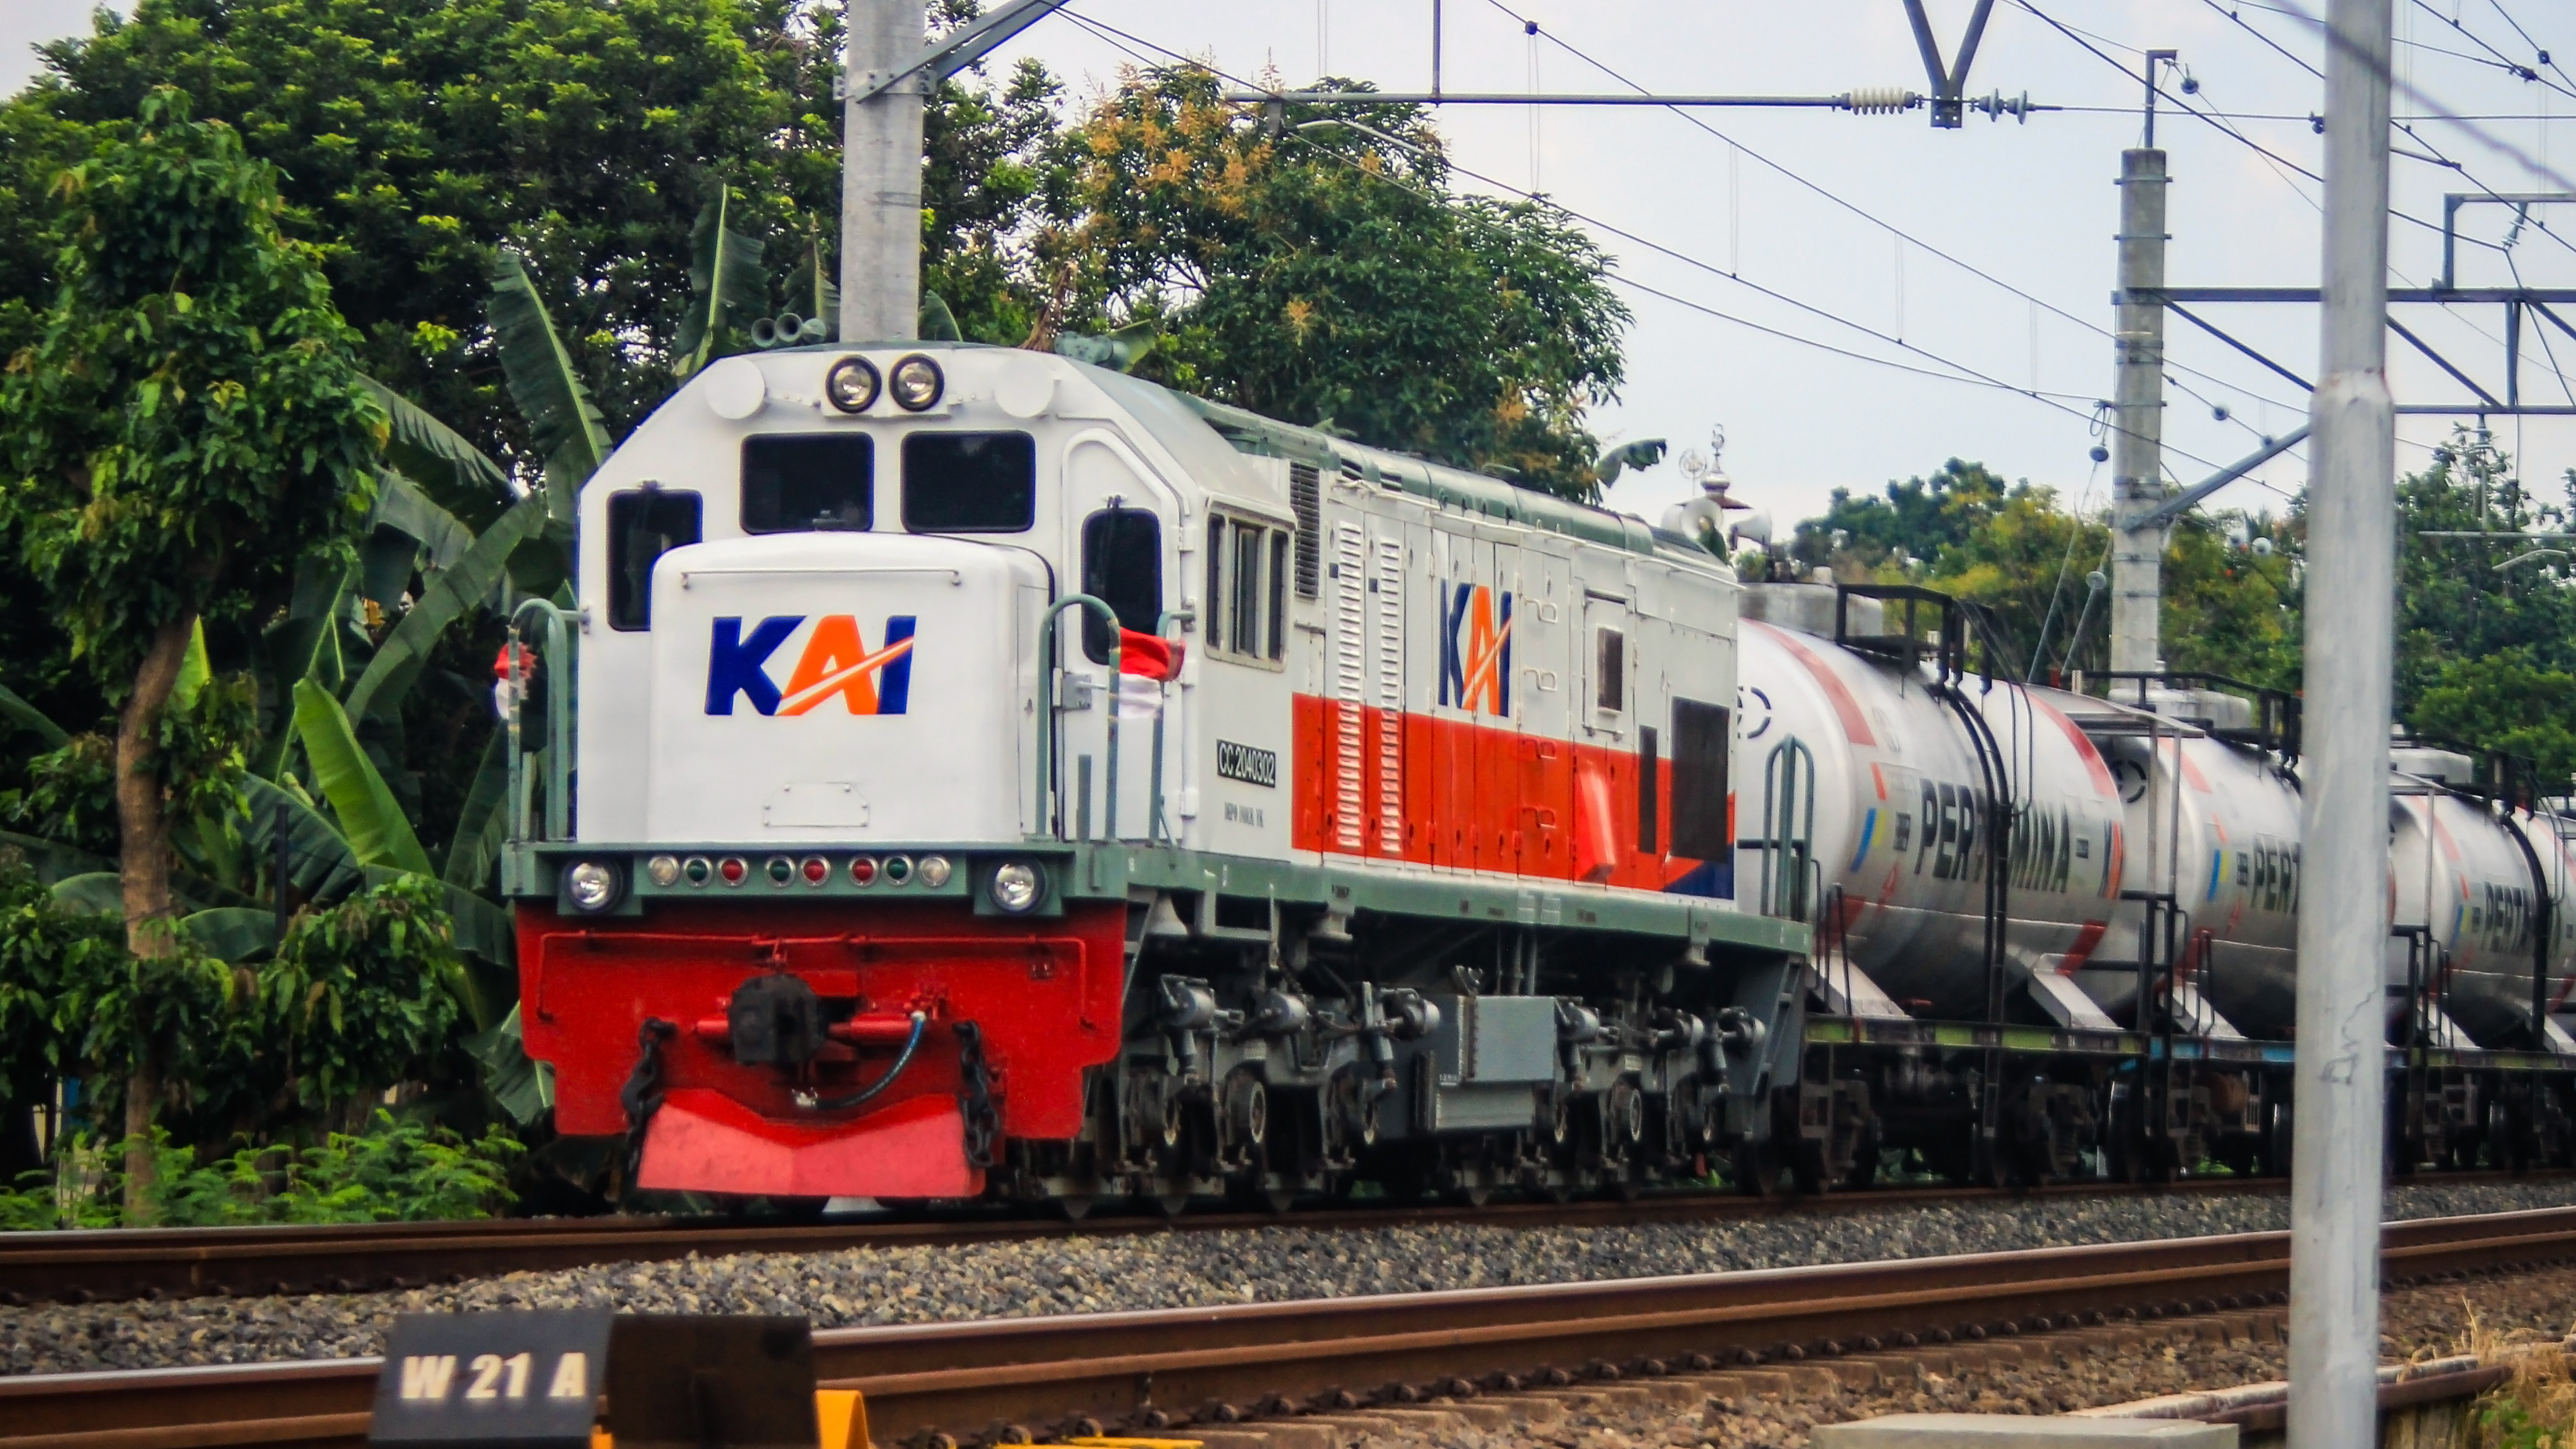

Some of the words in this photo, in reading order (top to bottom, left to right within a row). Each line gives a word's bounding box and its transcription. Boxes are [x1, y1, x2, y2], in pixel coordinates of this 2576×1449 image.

[705, 615, 917, 715] KAI
[1438, 579, 1511, 717] KAI
[1219, 743, 1233, 775] CC
[1235, 746, 1275, 784] 2040302
[1914, 777, 2070, 893] PERTMINA
[401, 1355, 457, 1398] W
[465, 1353, 531, 1398] 21
[548, 1352, 585, 1397] A
